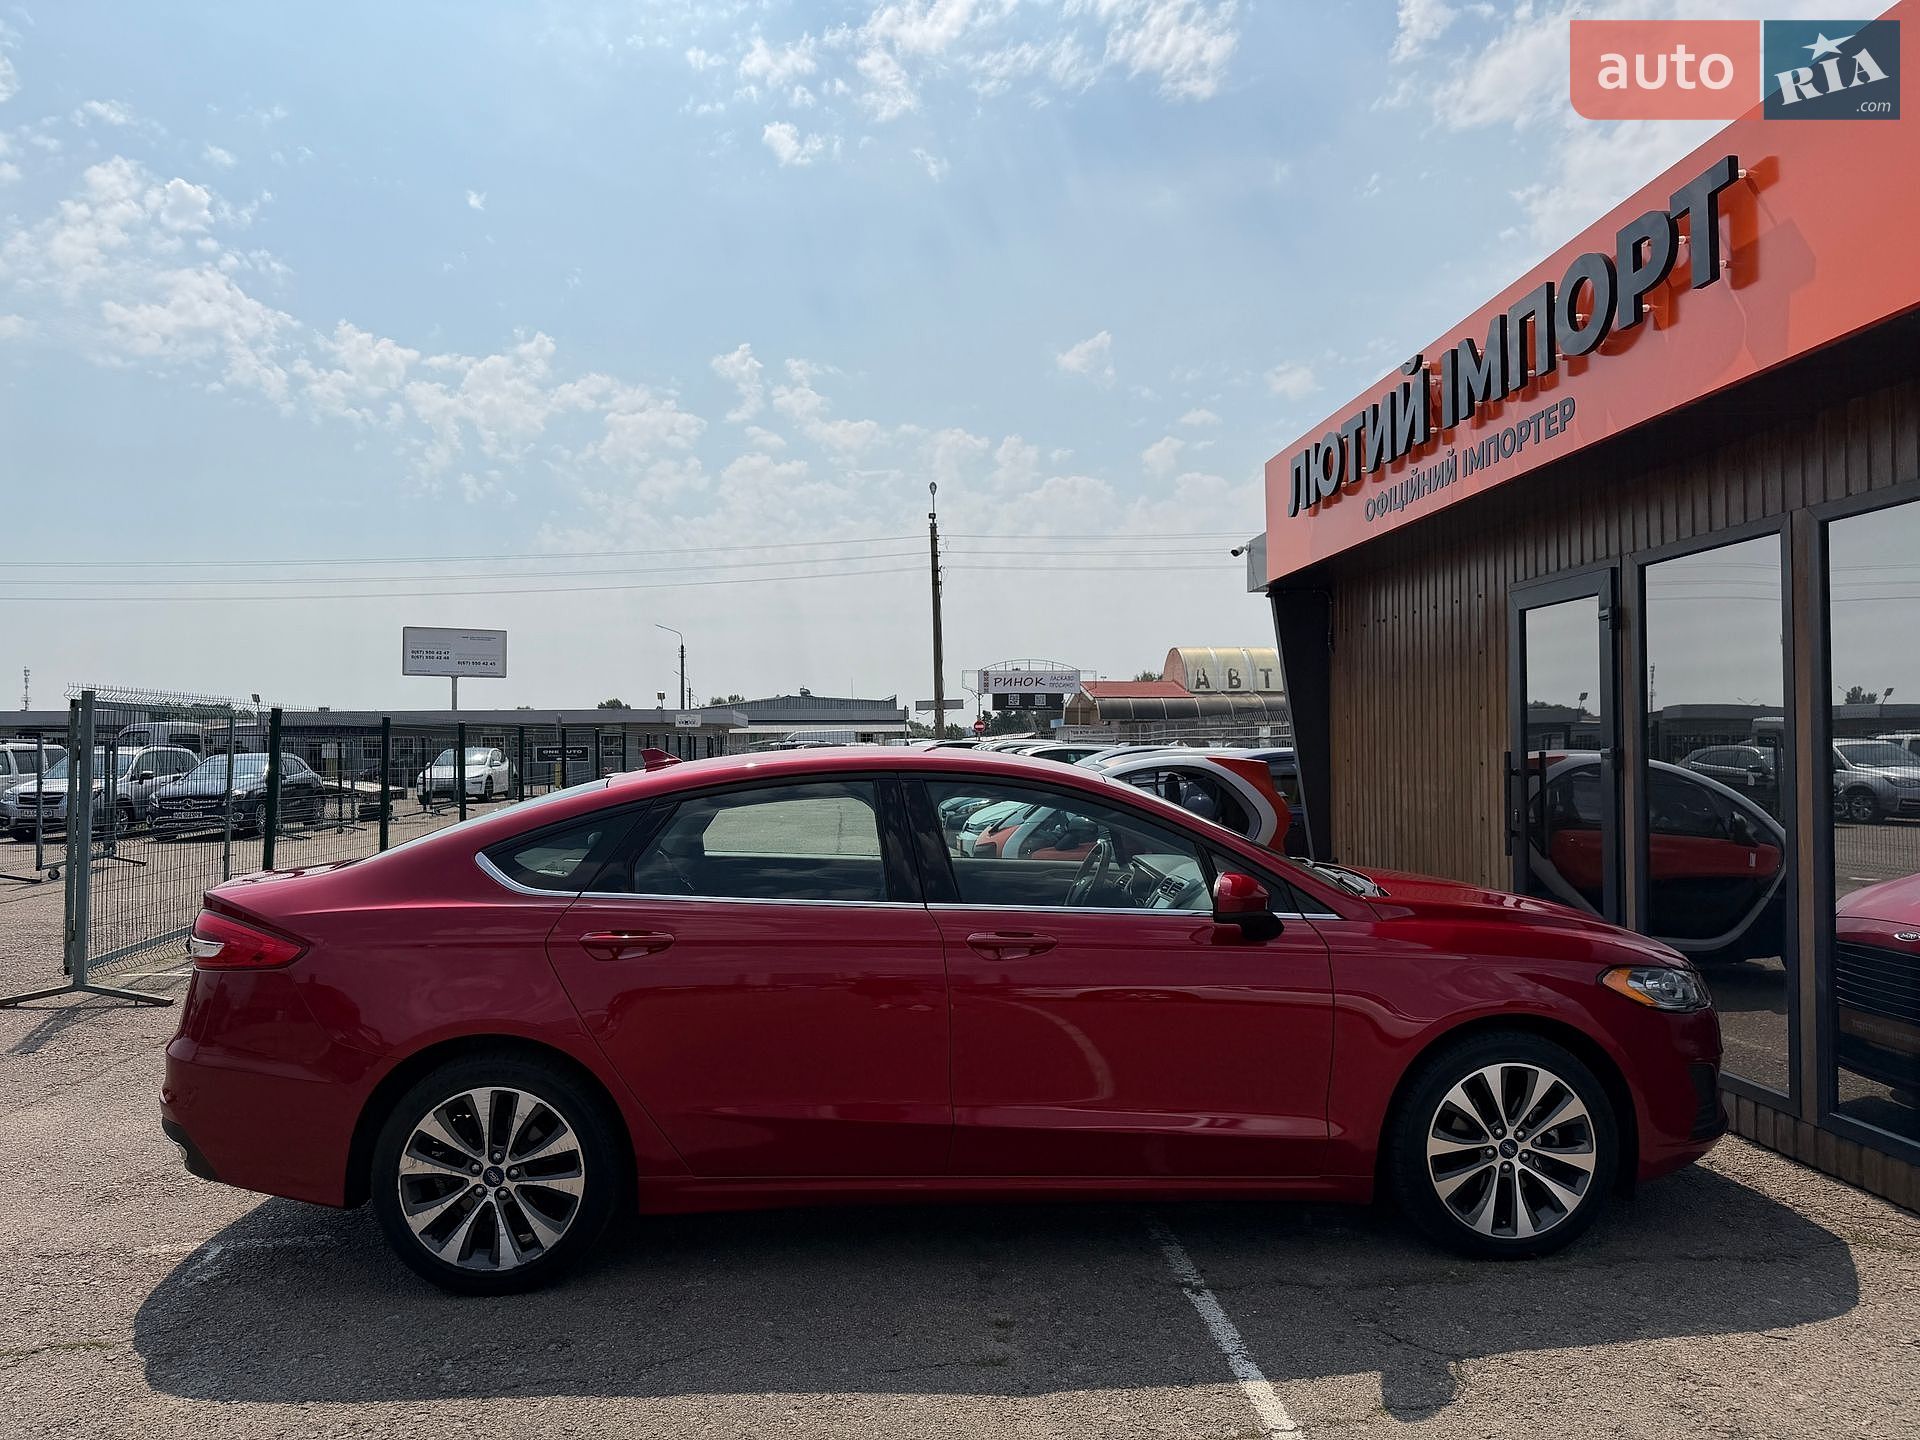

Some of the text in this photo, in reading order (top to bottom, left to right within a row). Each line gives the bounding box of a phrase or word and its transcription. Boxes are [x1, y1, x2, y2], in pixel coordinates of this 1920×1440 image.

[1288, 155, 1738, 518] ЛЮТИЙ ІМПОРТ
[1365, 396, 1576, 523] ОФІЦІЙНИЙ ІМПОРТЕР
[993, 677, 1046, 688] РИНОК
